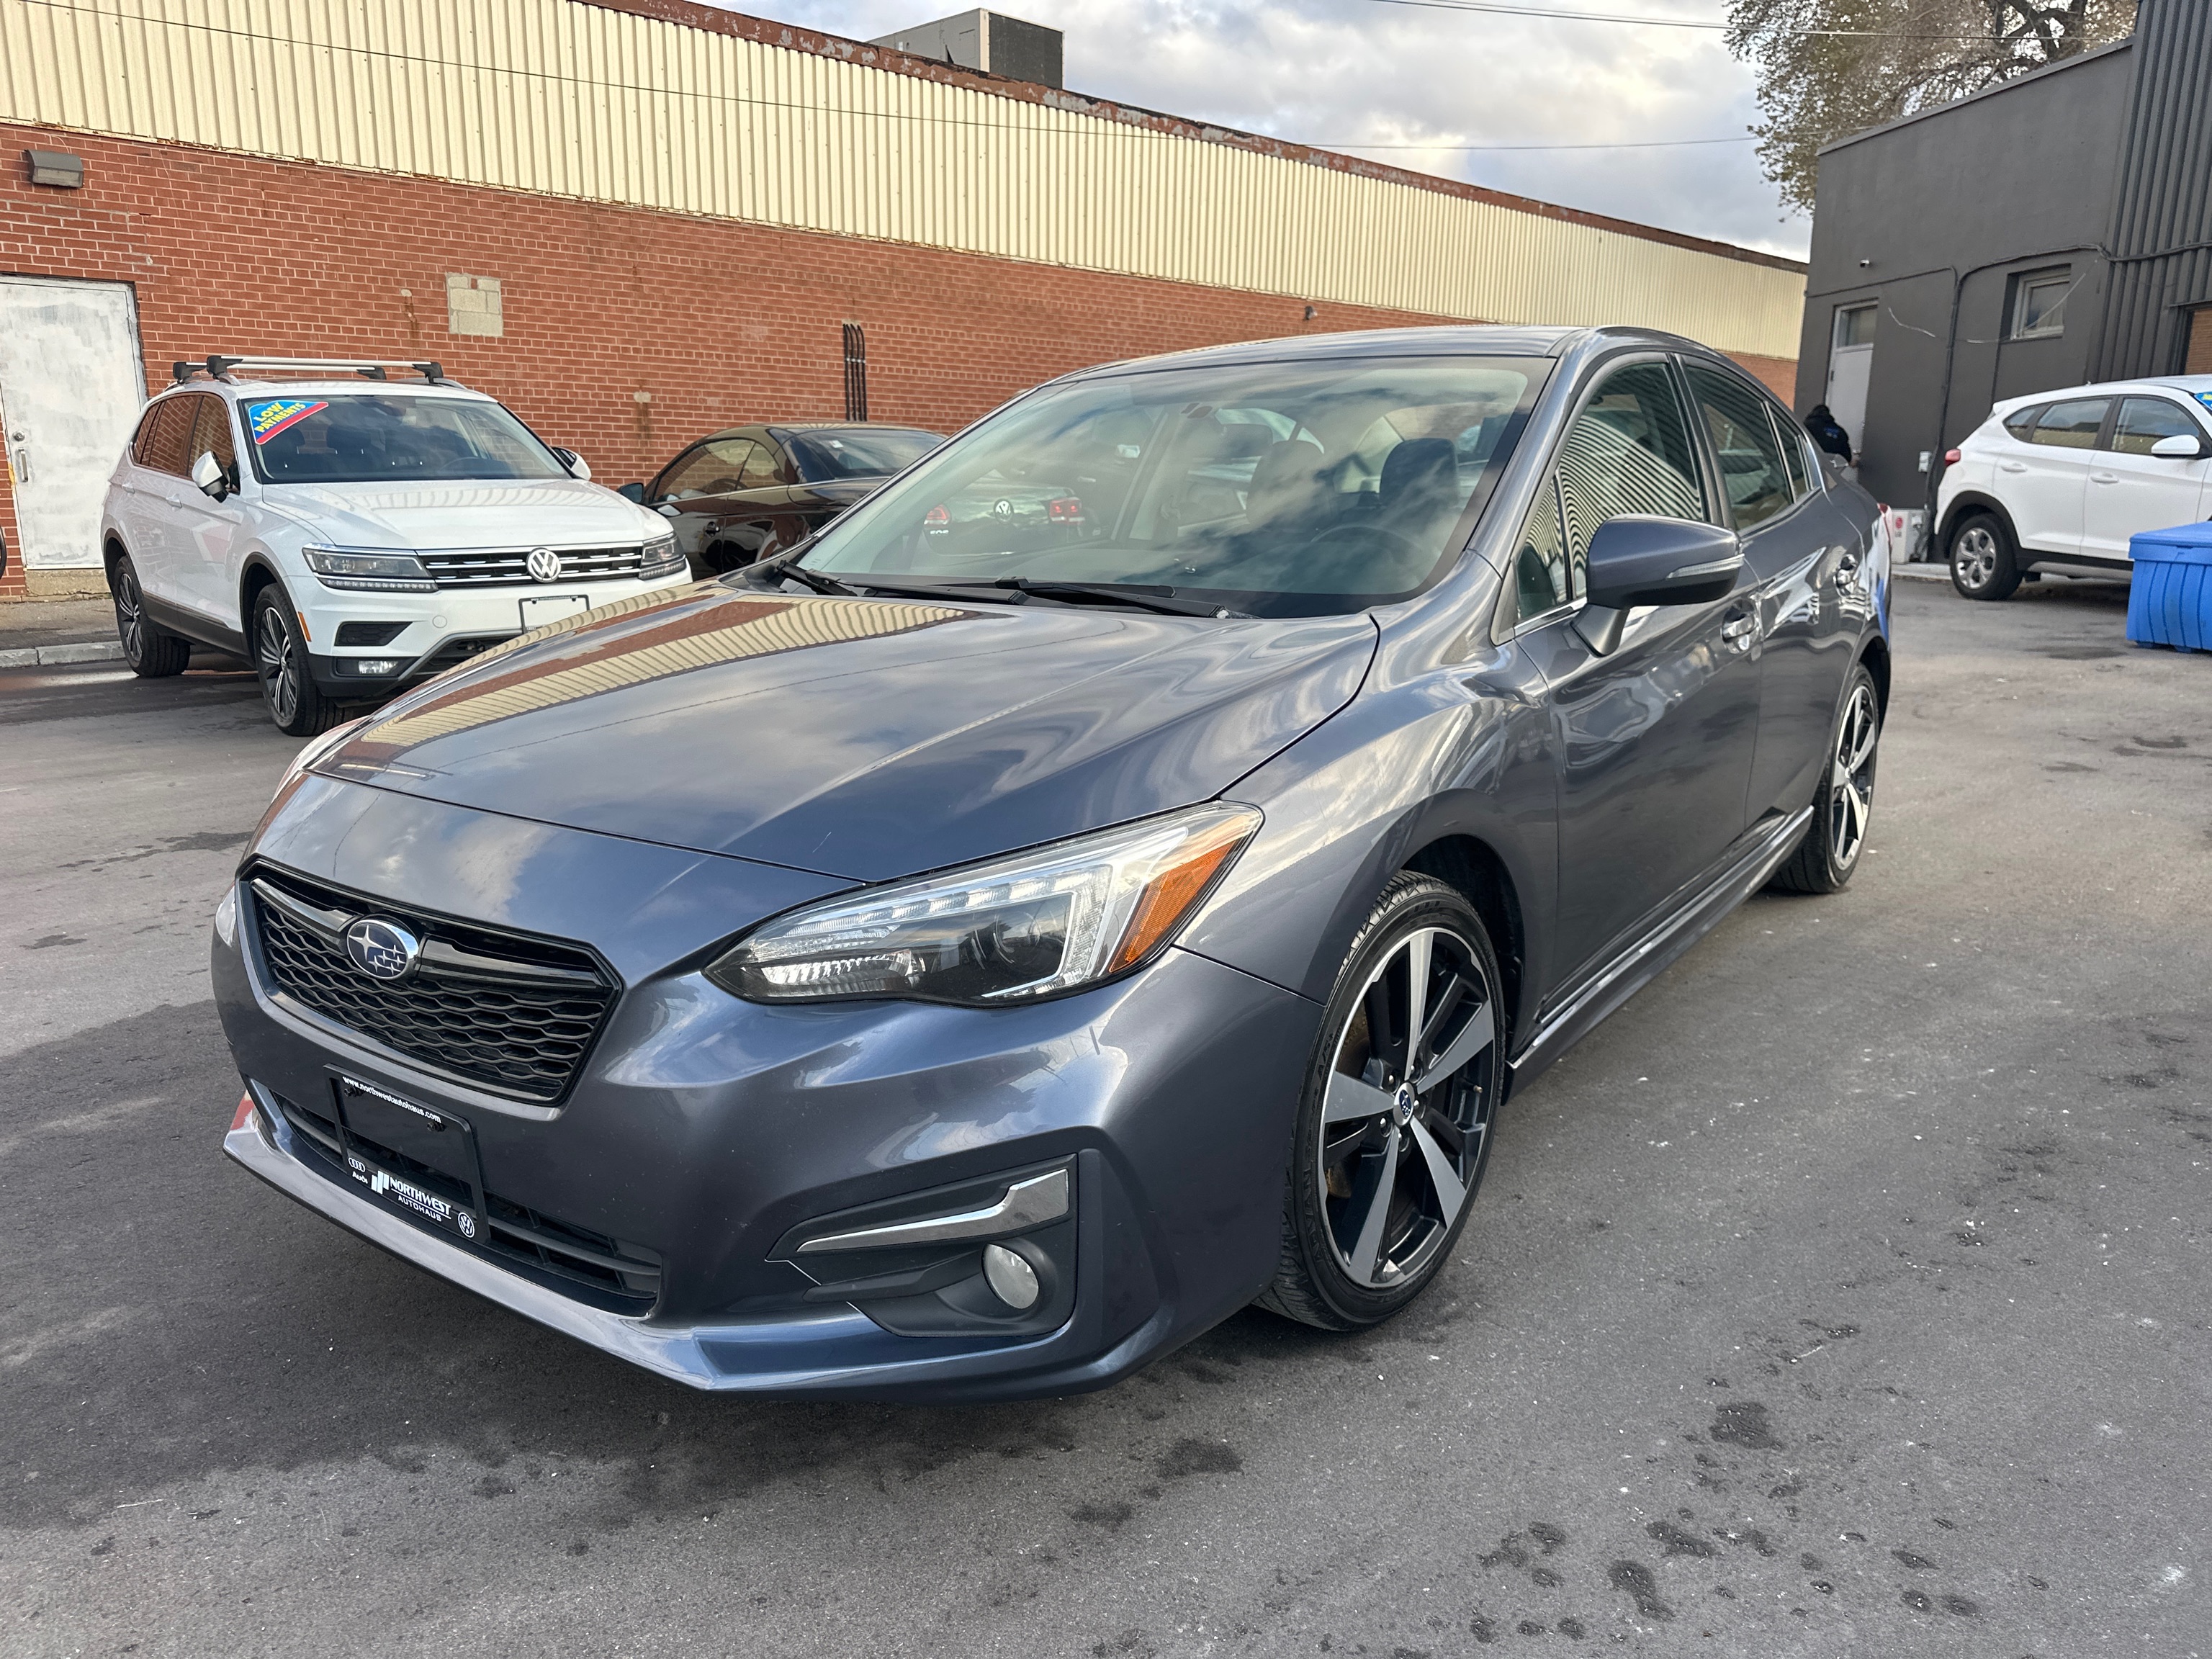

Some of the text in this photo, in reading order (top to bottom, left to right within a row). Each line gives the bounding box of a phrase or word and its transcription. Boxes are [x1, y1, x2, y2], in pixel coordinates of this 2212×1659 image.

[253, 402, 284, 422] LOW
[254, 403, 306, 433] PAYMENTS
[342, 1076, 442, 1124] www.northwestautohaus.com
[352, 1171, 369, 1184] Audi
[390, 1177, 451, 1215] NORTHWEST
[398, 1195, 442, 1222] AUTOHAUS
